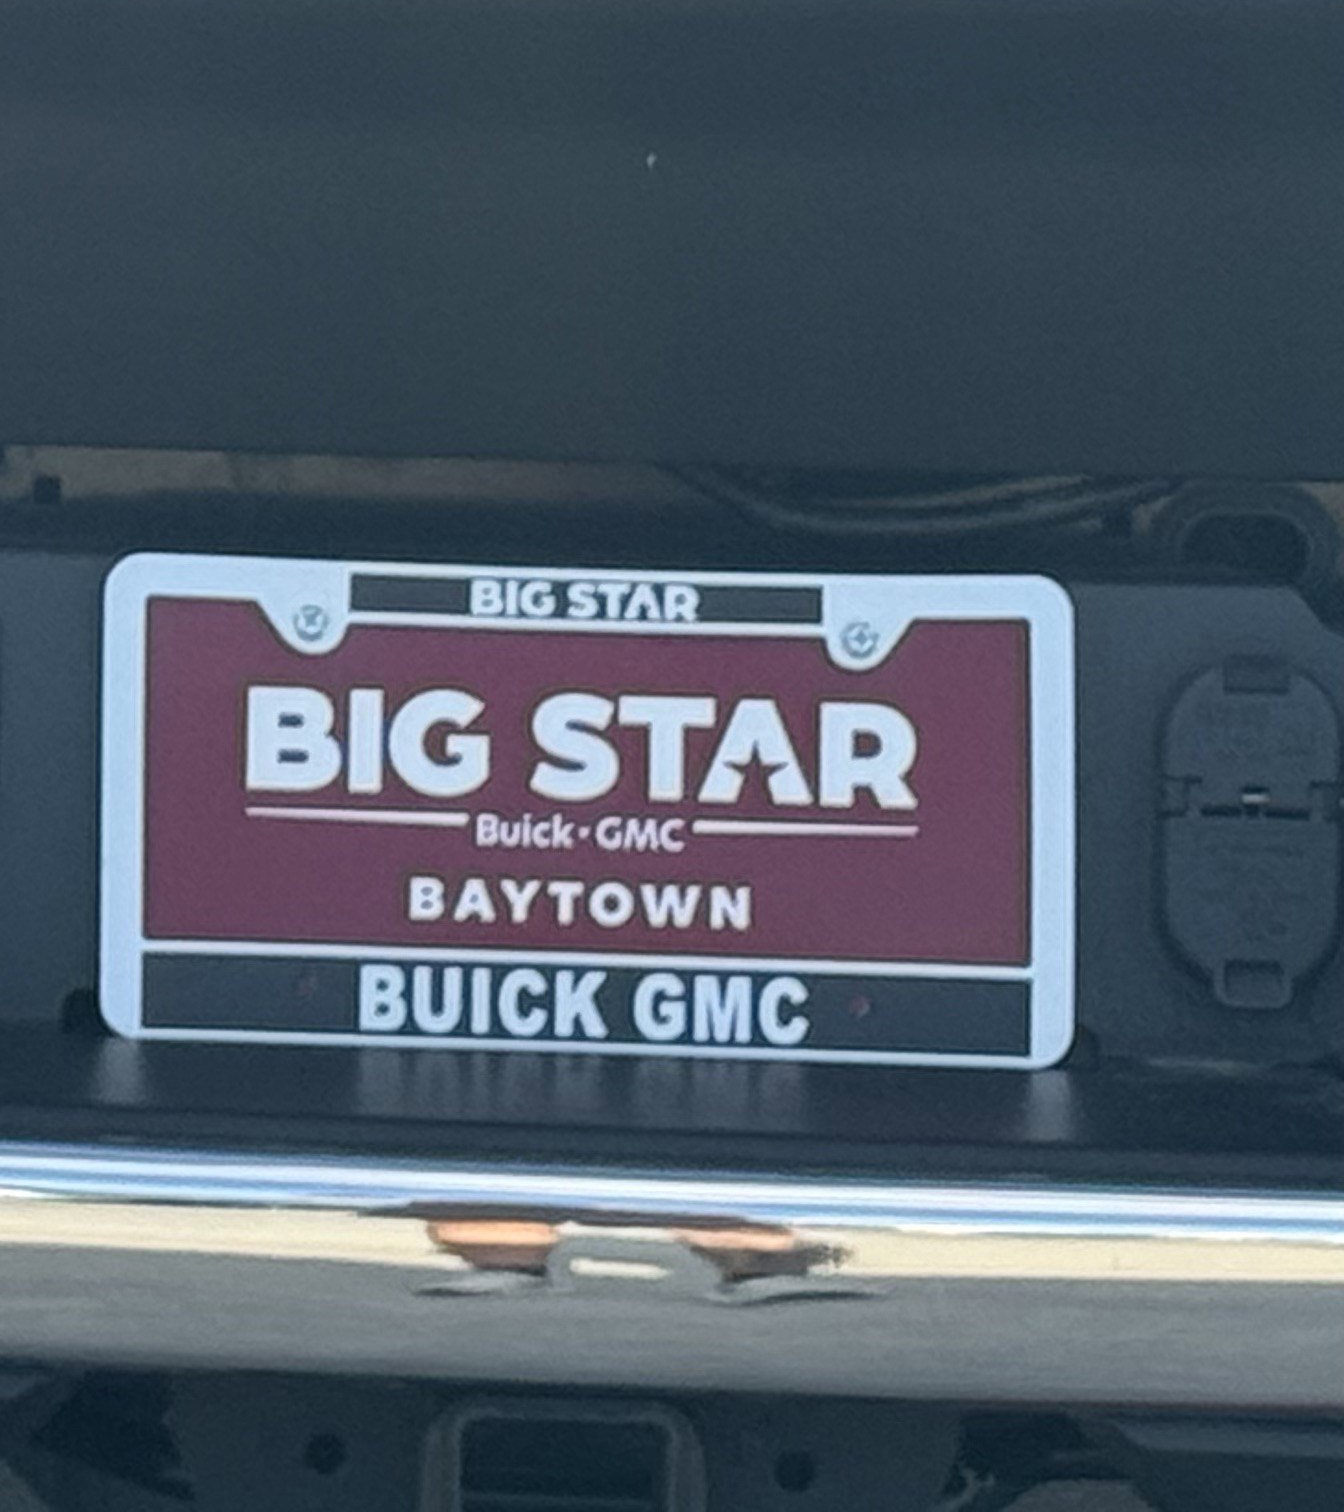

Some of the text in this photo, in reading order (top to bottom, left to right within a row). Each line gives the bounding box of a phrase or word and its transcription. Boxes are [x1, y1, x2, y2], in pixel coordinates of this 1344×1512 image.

[470, 579, 700, 622] BIG STAR
[245, 686, 918, 810] BIG STAR
[408, 876, 752, 931] BAYTOWN
[358, 964, 811, 1045] BUICK GMC
